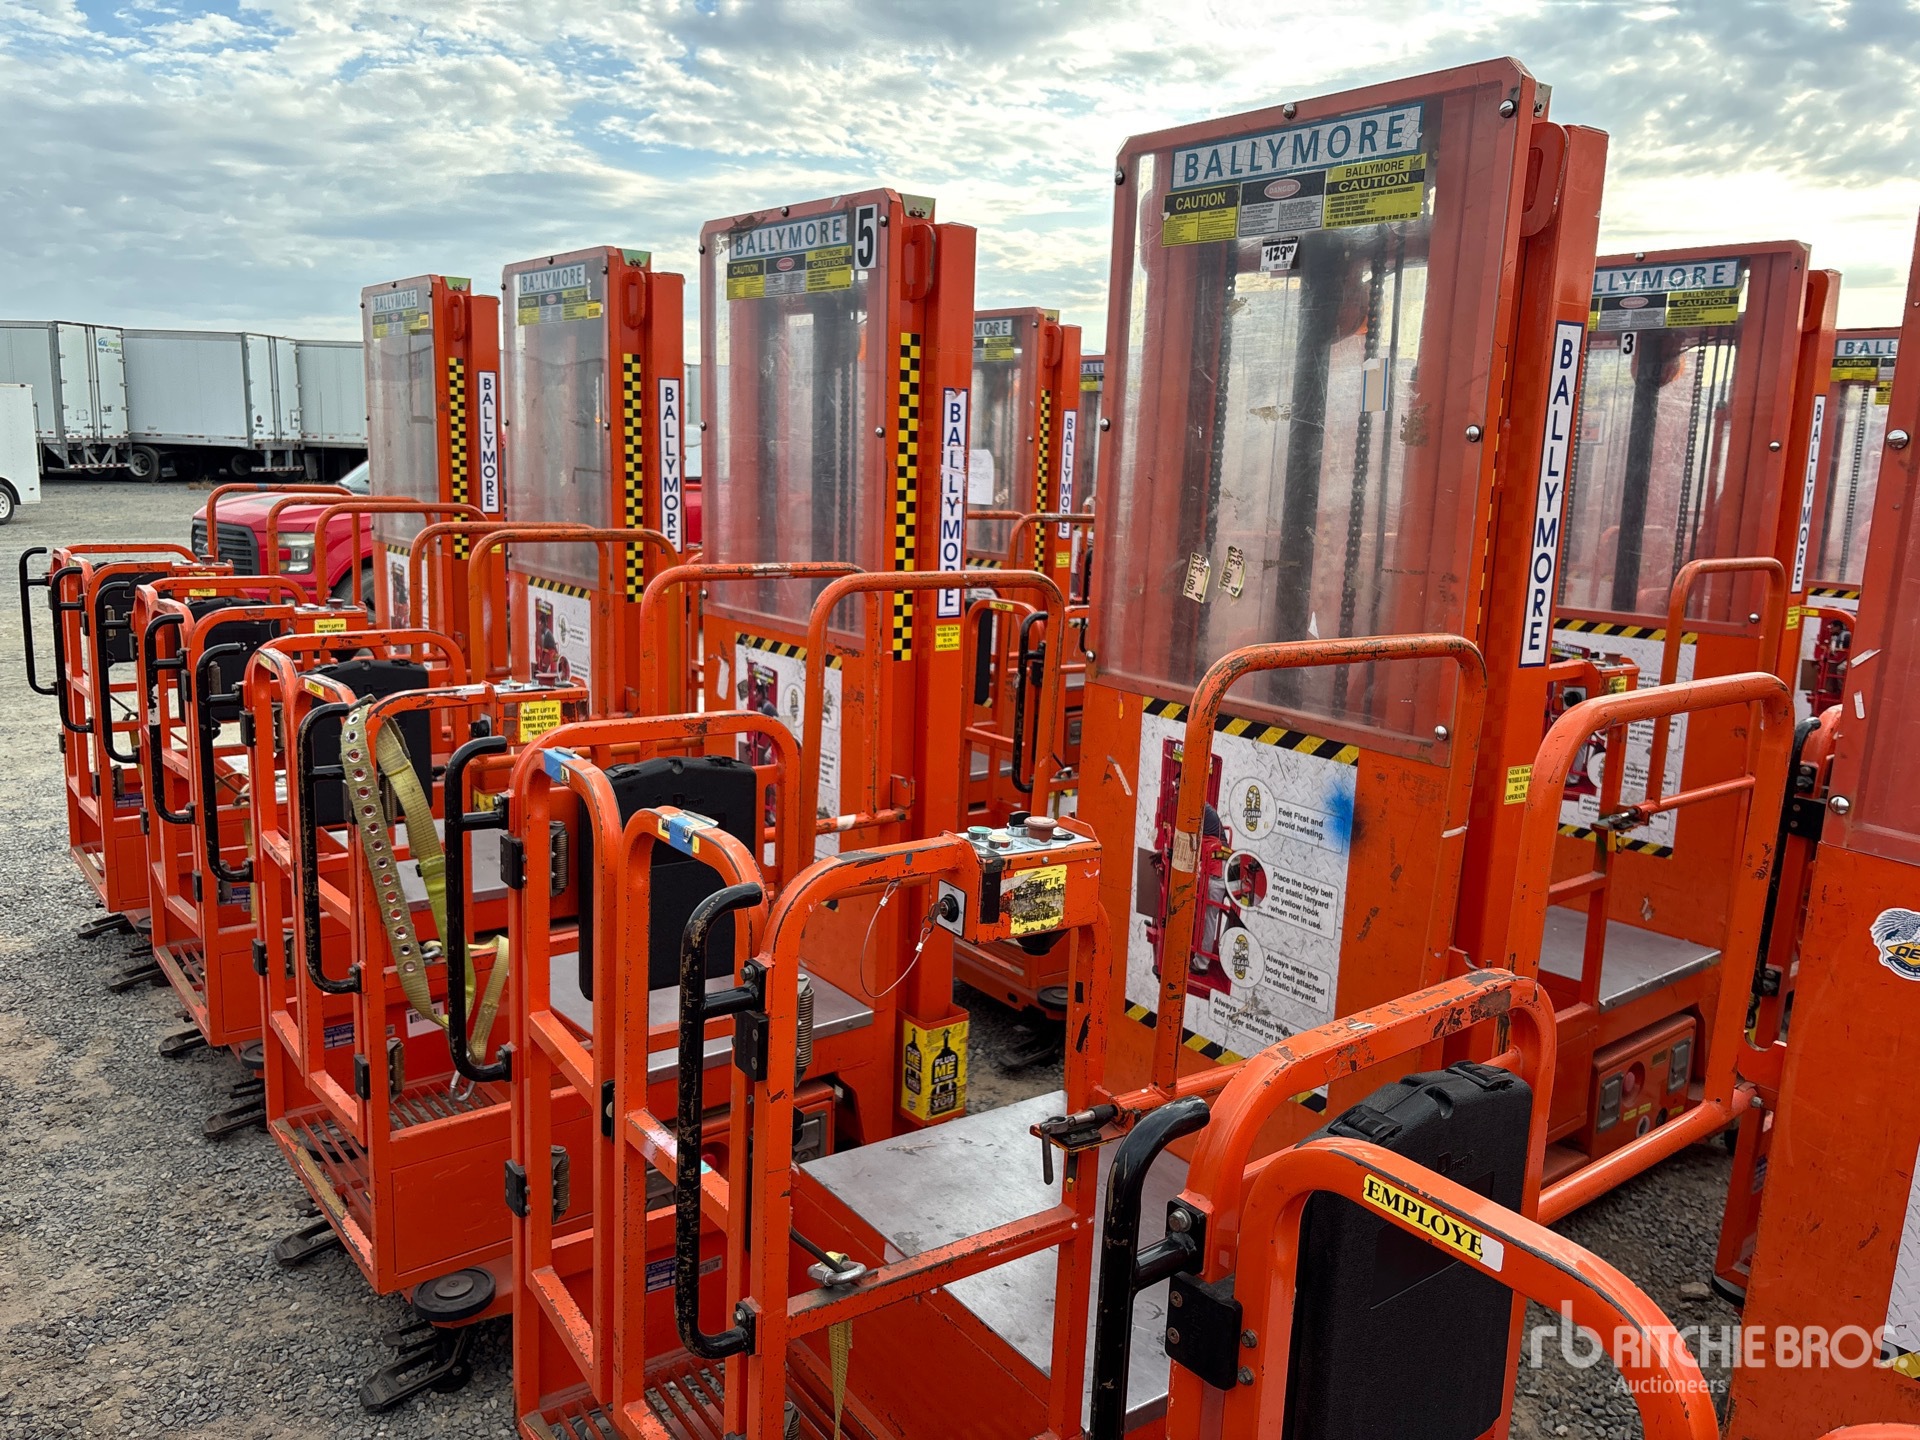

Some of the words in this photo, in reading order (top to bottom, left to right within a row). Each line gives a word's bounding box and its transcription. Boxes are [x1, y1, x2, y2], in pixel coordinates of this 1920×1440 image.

[1184, 113, 1405, 182] BALLYMORE
[1346, 160, 1404, 178] BALLYMORE
[1338, 173, 1410, 192] CAUTION
[1175, 192, 1226, 210] CAUTION
[736, 218, 841, 256] BALLYMORE
[858, 208, 874, 267] 5
[732, 264, 759, 276] CAUTION
[812, 258, 845, 268] CAUTION
[375, 291, 416, 311] BALLYMORE
[1677, 298, 1729, 307] CAUTION
[1623, 334, 1634, 354] 3
[482, 378, 496, 506] BALLYMORE
[942, 402, 962, 607] BALLYMOE
[1528, 338, 1572, 650] BALLYMORE
[1795, 404, 1822, 584] BALLYMORE
[1277, 820, 1295, 831] avoid
[1296, 825, 1325, 841] twisting.
[1279, 808, 1292, 819] Feet
[1294, 813, 1309, 823] First
[1311, 818, 1324, 828] and
[1272, 884, 1284, 893] and
[1285, 888, 1302, 900] static
[1305, 894, 1329, 910] lanyard
[1273, 872, 1290, 884] Place
[1292, 879, 1302, 888] the
[1303, 882, 1319, 895] body
[1321, 887, 1333, 899] belt
[1271, 905, 1287, 916] when
[1289, 912, 1299, 921] not
[1301, 916, 1307, 924] in
[1308, 920, 1322, 930] use.
[1281, 898, 1301, 910] yellow
[1303, 905, 1319, 917] hook
[1266, 965, 1281, 979] body
[1283, 974, 1295, 983] belt
[1296, 978, 1325, 995] attached
[1267, 954, 1289, 969] Always
[1291, 966, 1306, 976] wear
[1307, 971, 1318, 981] the
[1273, 981, 1290, 992] static
[1292, 987, 1318, 1004] lanyard.
[1213, 1008, 1225, 1018] and
[1226, 1016, 1244, 1026] nver
[1245, 1023, 1263, 1036] stand
[1265, 1032, 1273, 1040] on
[1214, 997, 1236, 1012] Always
[1255, 1016, 1275, 1030] within
[935, 1054, 956, 1066] PLUG
[936, 1062, 955, 1078] ME
[1366, 1178, 1482, 1257] EMPLOYE
